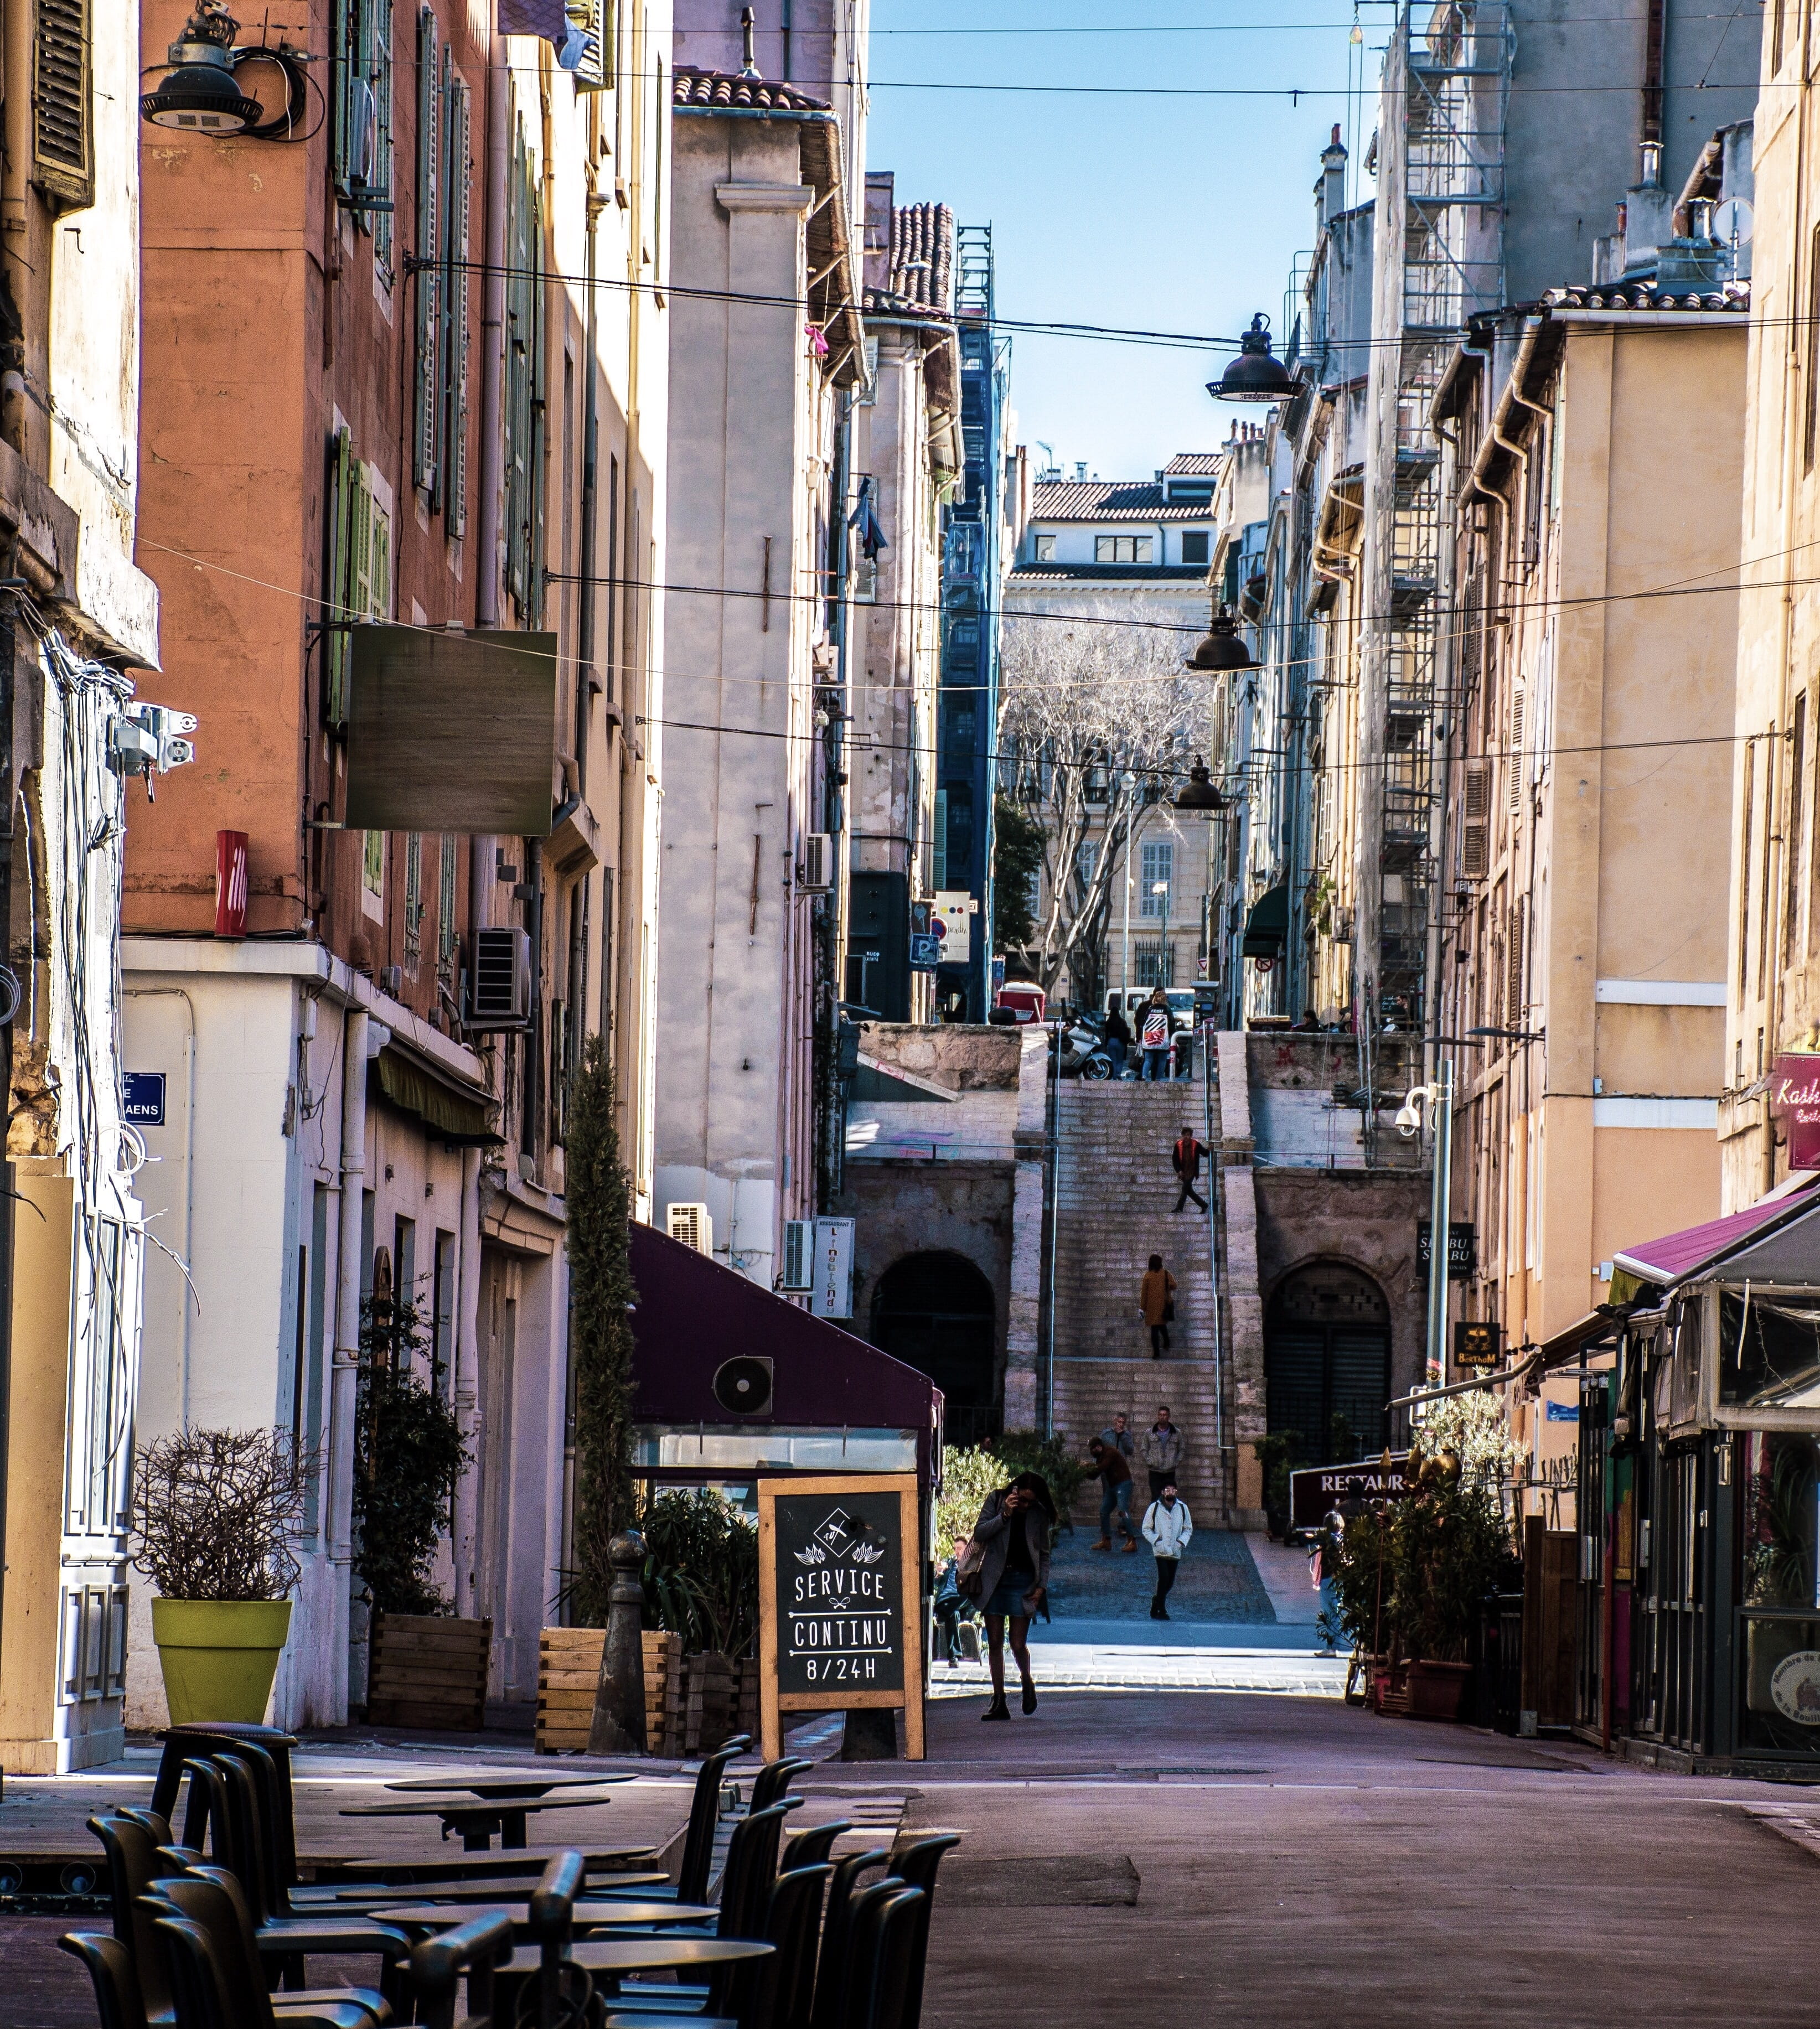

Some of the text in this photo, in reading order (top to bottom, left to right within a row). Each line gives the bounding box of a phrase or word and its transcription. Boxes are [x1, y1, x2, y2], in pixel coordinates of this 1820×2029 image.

[125, 1105, 158, 1115] AENS
[795, 1569, 884, 1601] SERVICE
[795, 1619, 886, 1646] CONTINU
[807, 1658, 875, 1680] 8/24H
